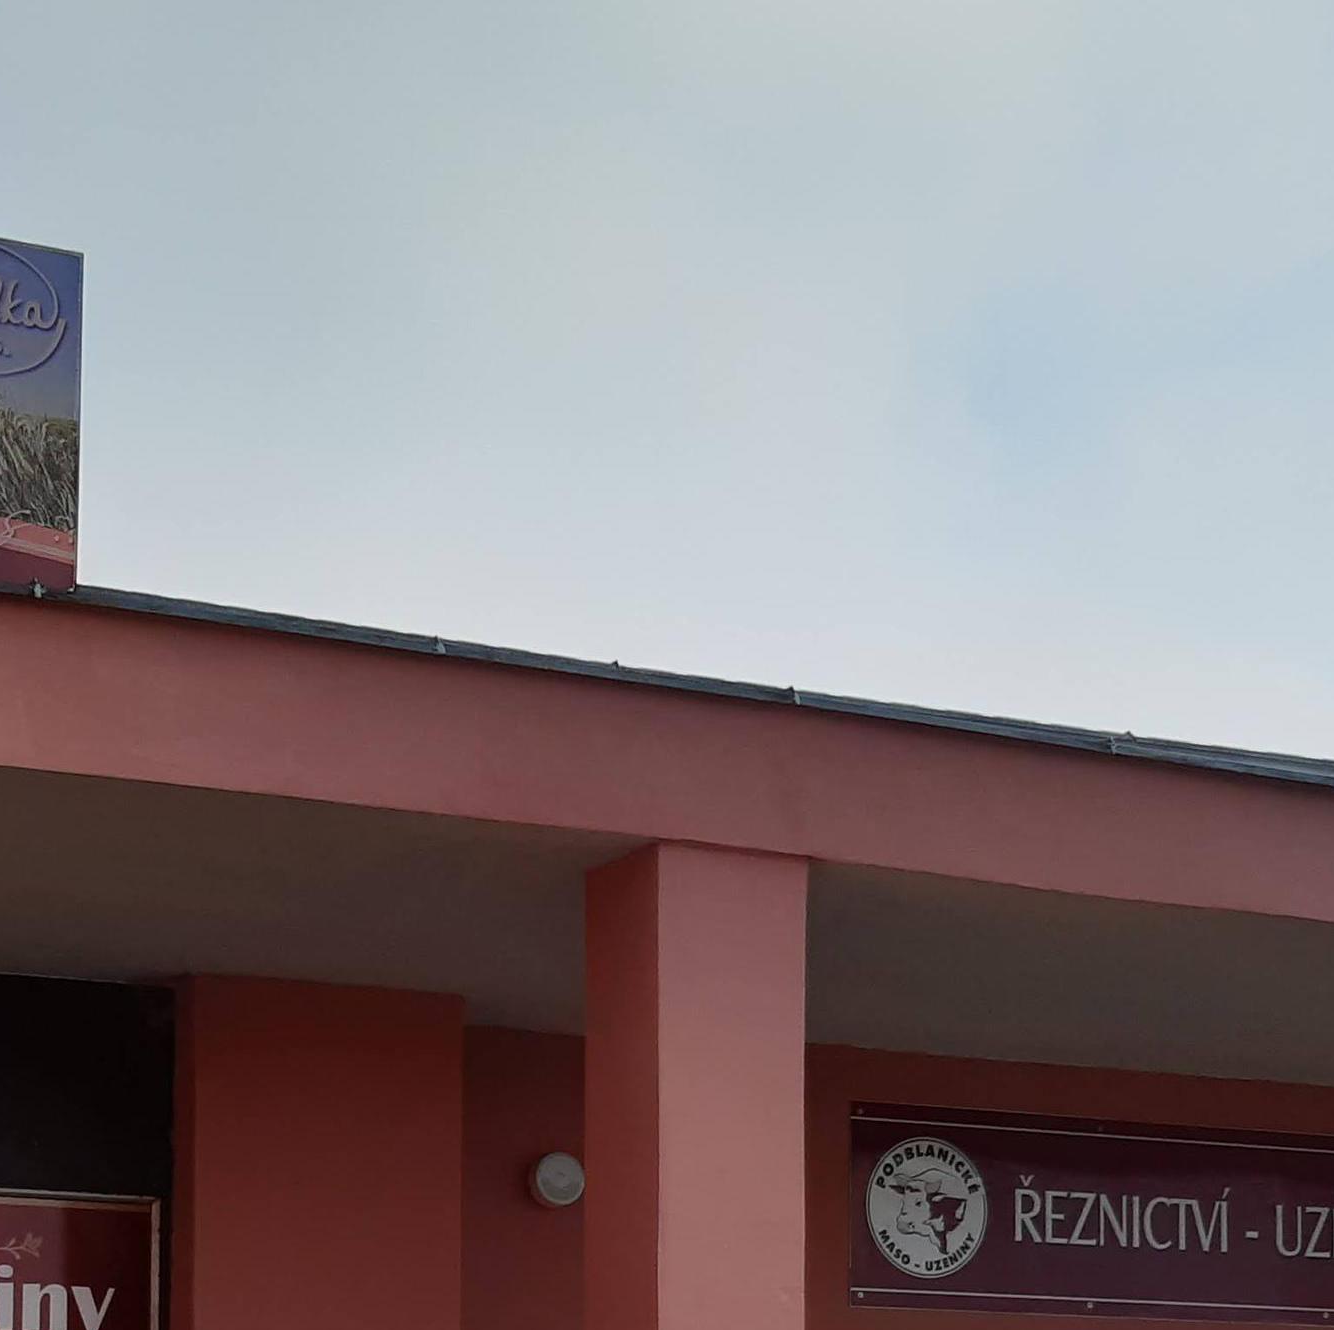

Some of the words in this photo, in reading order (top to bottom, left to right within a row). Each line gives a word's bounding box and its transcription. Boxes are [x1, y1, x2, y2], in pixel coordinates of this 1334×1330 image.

[875, 1144, 981, 1195] PODBLANICKÉ
[1013, 1174, 1230, 1253] ŘEZNICTVÍ
[878, 1229, 910, 1265] MASO
[925, 1233, 975, 1271] UZENINY
